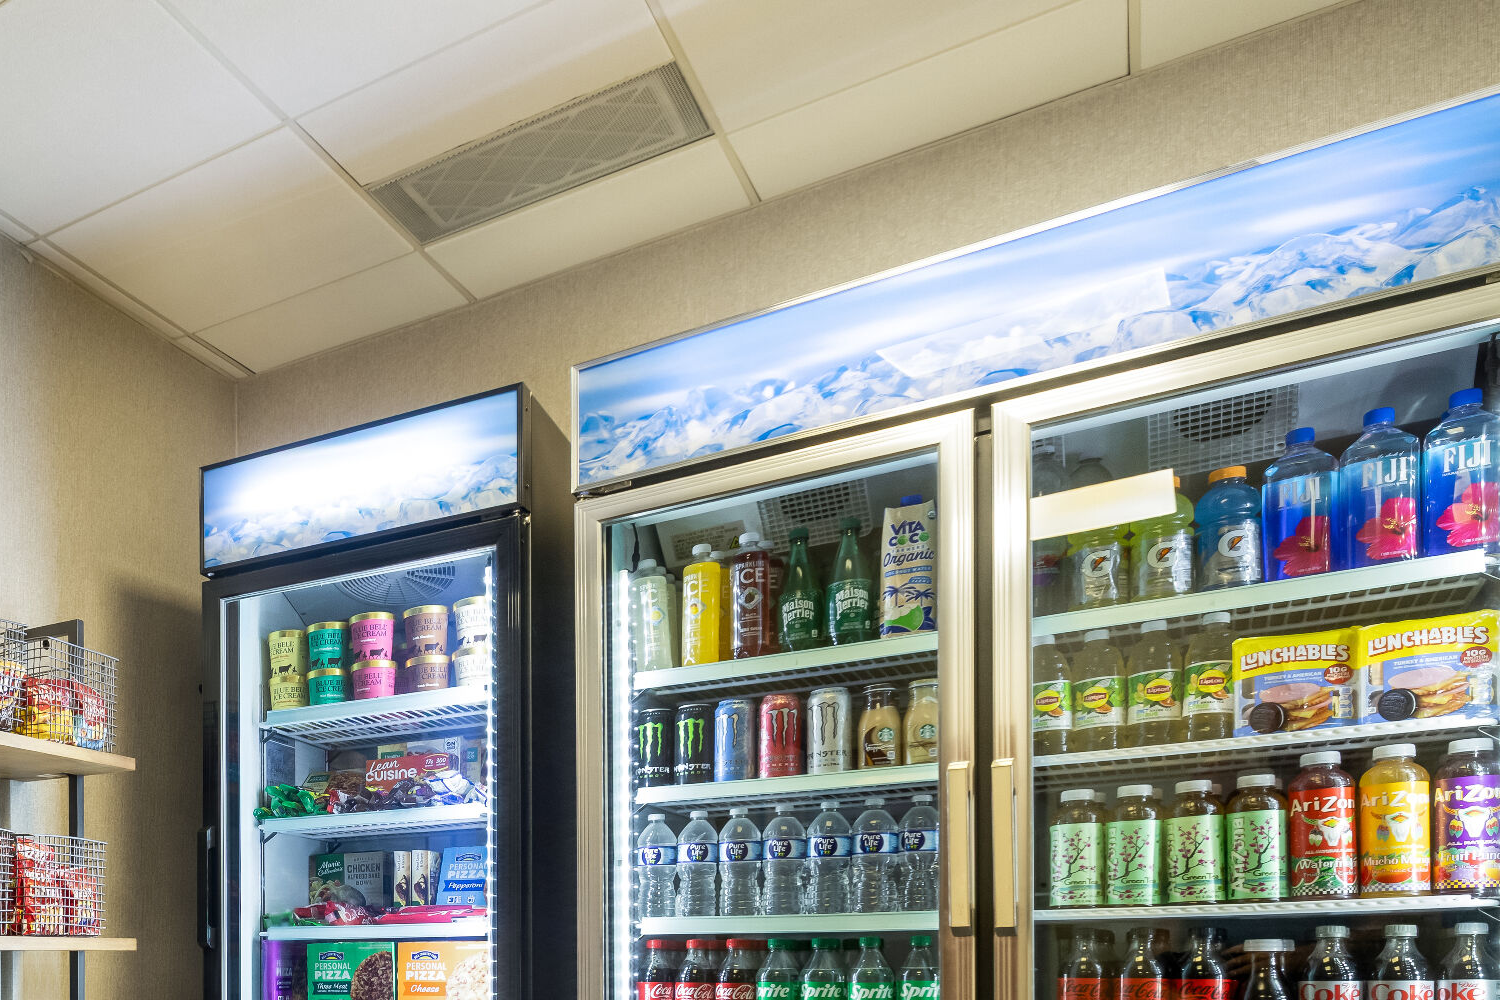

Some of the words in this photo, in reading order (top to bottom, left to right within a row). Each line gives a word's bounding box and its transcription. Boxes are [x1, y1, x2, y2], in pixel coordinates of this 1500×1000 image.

[1443, 440, 1492, 473] FIJI
[1362, 457, 1407, 488] FIJI
[1279, 477, 1320, 508] FIJI
[890, 520, 925, 536] VITA
[884, 549, 934, 567] Organic
[836, 586, 868, 600] Maison
[782, 599, 814, 613] Maison
[1368, 626, 1489, 656] LUNCHABLES
[1240, 644, 1349, 671] LUNCHABLES
[1328, 666, 1348, 674] 10G
[369, 760, 400, 773] Lean
[1291, 796, 1355, 816] AriZon
[1364, 854, 1398, 866] Mucho
[1401, 855, 1429, 866] Mang
[1468, 849, 1500, 862] Punc
[319, 861, 341, 870] Marie
[347, 863, 381, 873] CHICKEN
[448, 870, 486, 879] PIZZA
[448, 882, 483, 891] Pepperoni
[315, 962, 351, 970] PERSONAL
[406, 962, 446, 970] PERSONAL
[314, 970, 351, 980] PIZZA
[405, 970, 446, 980] PIZZA
[410, 984, 439, 993] Cheese
[801, 983, 841, 1000] Sprite
